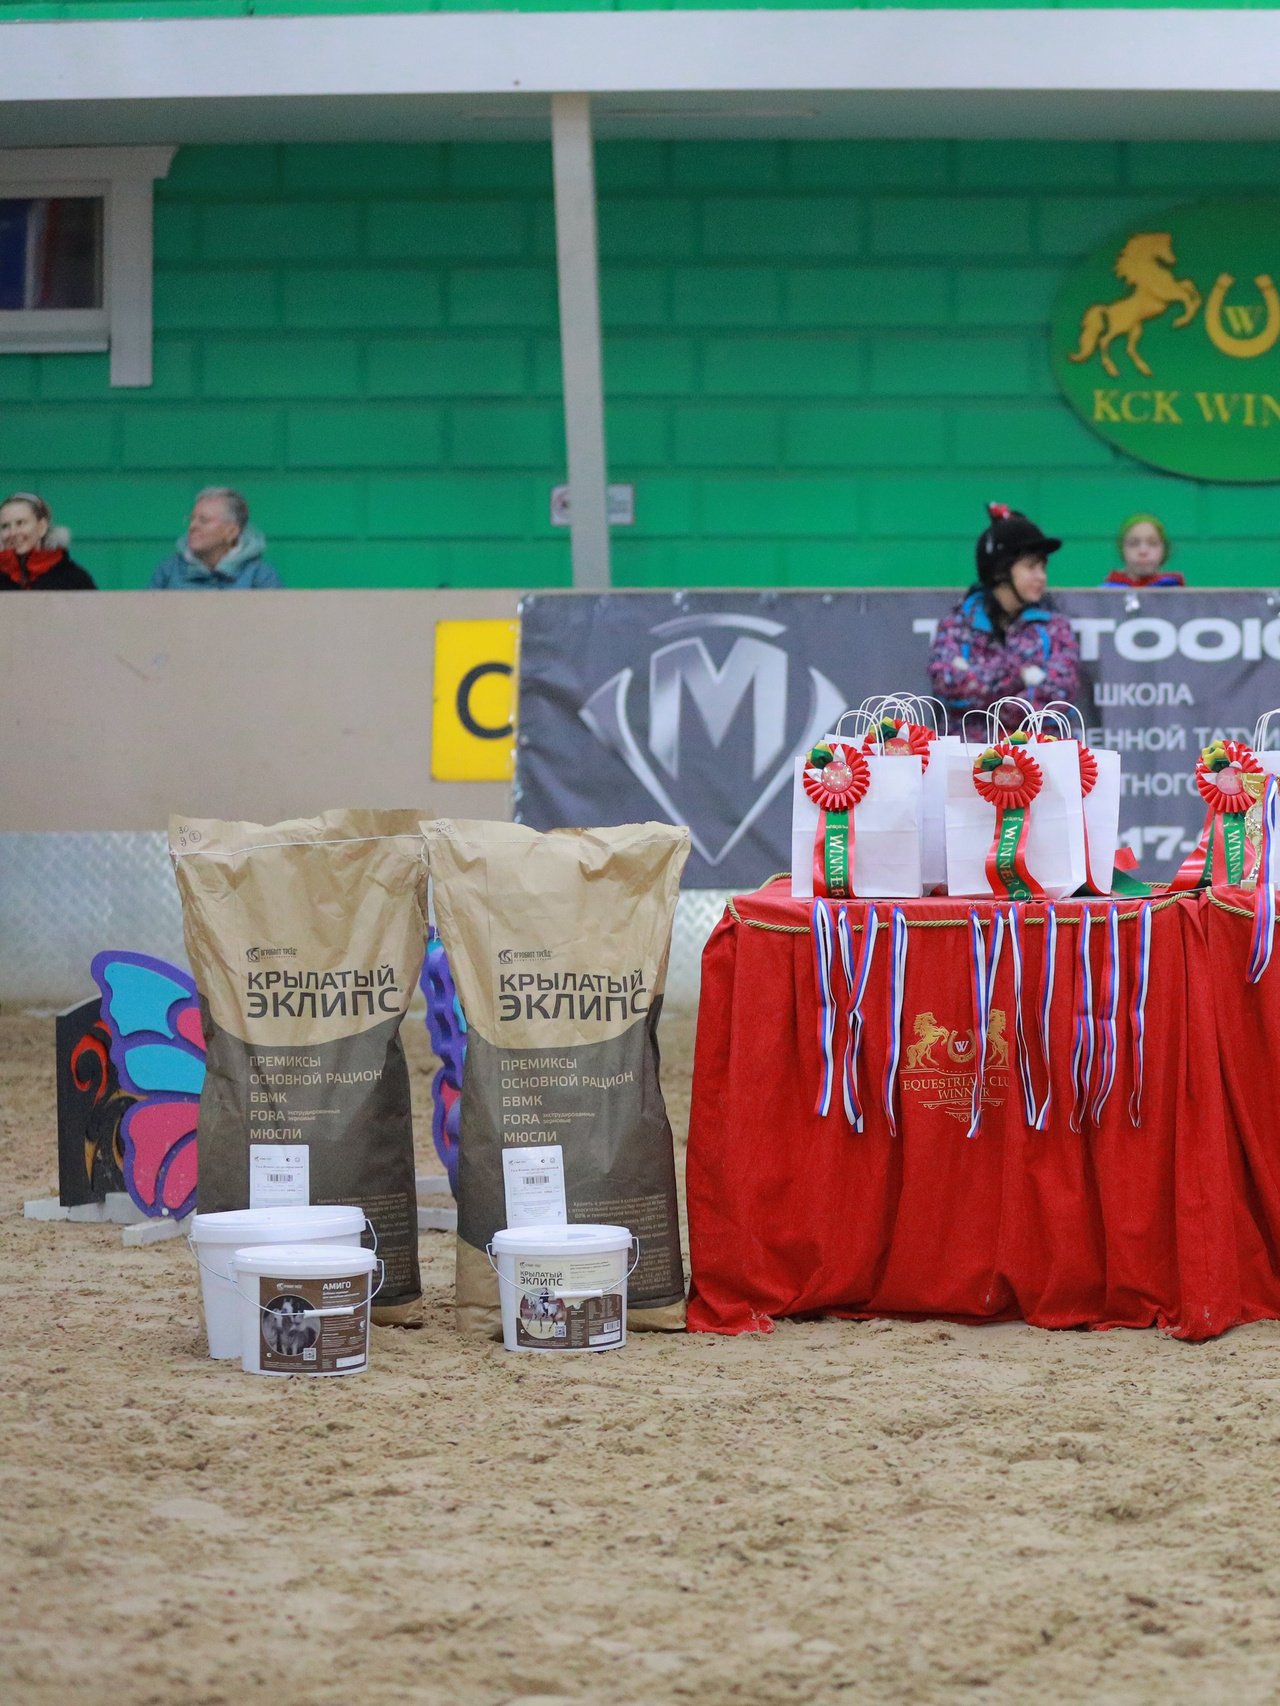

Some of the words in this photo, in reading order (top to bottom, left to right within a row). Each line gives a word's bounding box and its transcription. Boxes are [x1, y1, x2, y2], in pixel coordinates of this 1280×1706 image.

[1094, 683, 1194, 707] ШКОЛА
[1000, 825, 1020, 886] WINNER
[1227, 829, 1242, 885] WINNE
[829, 833, 847, 897] WINNER
[248, 964, 394, 990] КРЫЛАТЫЙ
[500, 968, 643, 993] КРЫЛАТЫЙ
[247, 987, 400, 1018] ЭКЛИПС
[499, 988, 648, 1021] ЭКЛИПС
[955, 1041, 969, 1053] W
[250, 1056, 321, 1068] ПРЕМИКСЫ
[501, 1058, 577, 1071] ПРЕМИКСЫ
[250, 1072, 322, 1085] ОСНОВНОЙ
[326, 1070, 382, 1084] РАЦИОН
[502, 1074, 578, 1089] ОСНОВНОЙ
[582, 1071, 634, 1089] РАЦИОН
[990, 1076, 1009, 1087] CLU
[250, 1092, 288, 1103] БВМК
[938, 1088, 990, 1100] WINNR
[503, 1095, 543, 1107] БВМК
[250, 1110, 286, 1121] FORA
[503, 1114, 540, 1125] FORA
[250, 1128, 302, 1140] МЮСЛИ
[504, 1131, 557, 1143] МЮСЛИ
[322, 1281, 351, 1290] АМИГО
[520, 1276, 563, 1286] ЭКЛИПС
